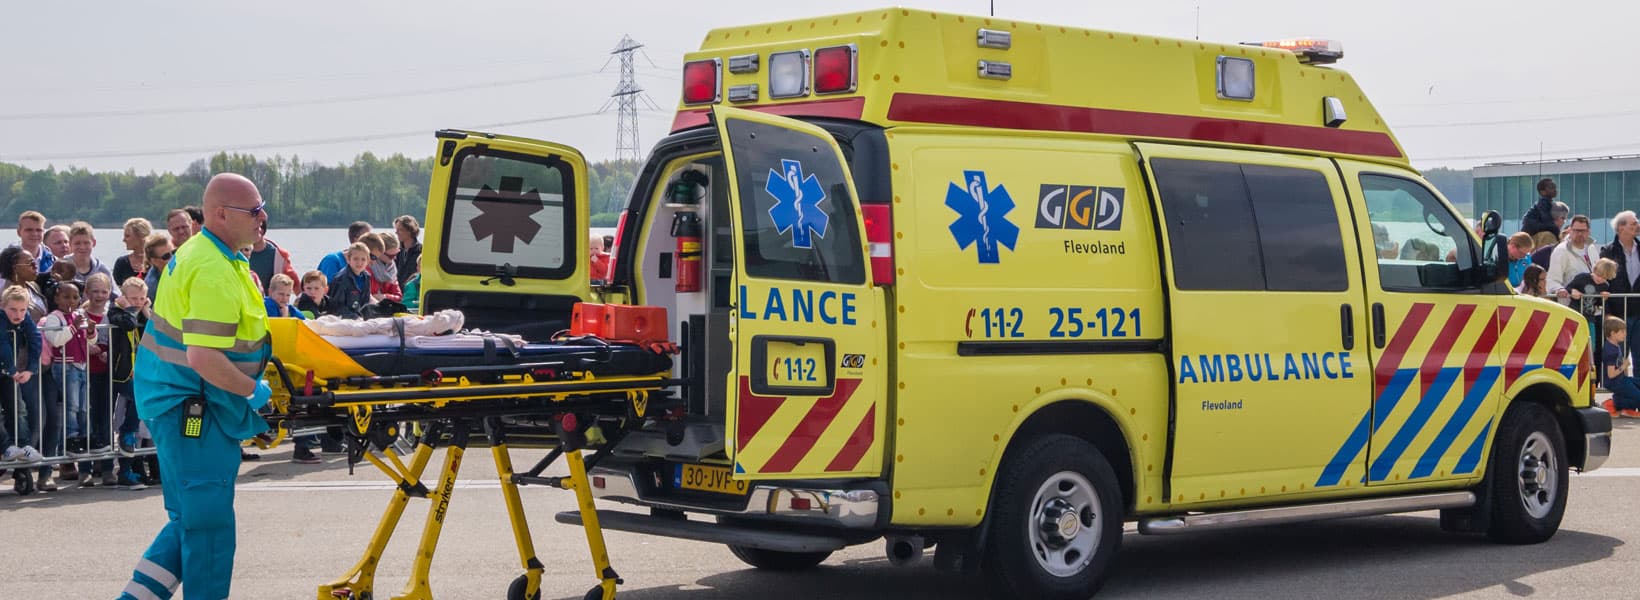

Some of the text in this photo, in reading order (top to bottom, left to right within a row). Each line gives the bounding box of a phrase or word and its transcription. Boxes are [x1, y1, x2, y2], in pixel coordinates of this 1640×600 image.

[1036, 185, 1124, 230] GGD
[1063, 239, 1126, 255] Flevoland
[739, 284, 857, 326] LANCE
[1048, 307, 1142, 338] 25-121
[1178, 351, 1355, 384] AMBULANCE
[1201, 399, 1243, 411] Flevoland
[435, 477, 454, 524] stryker
